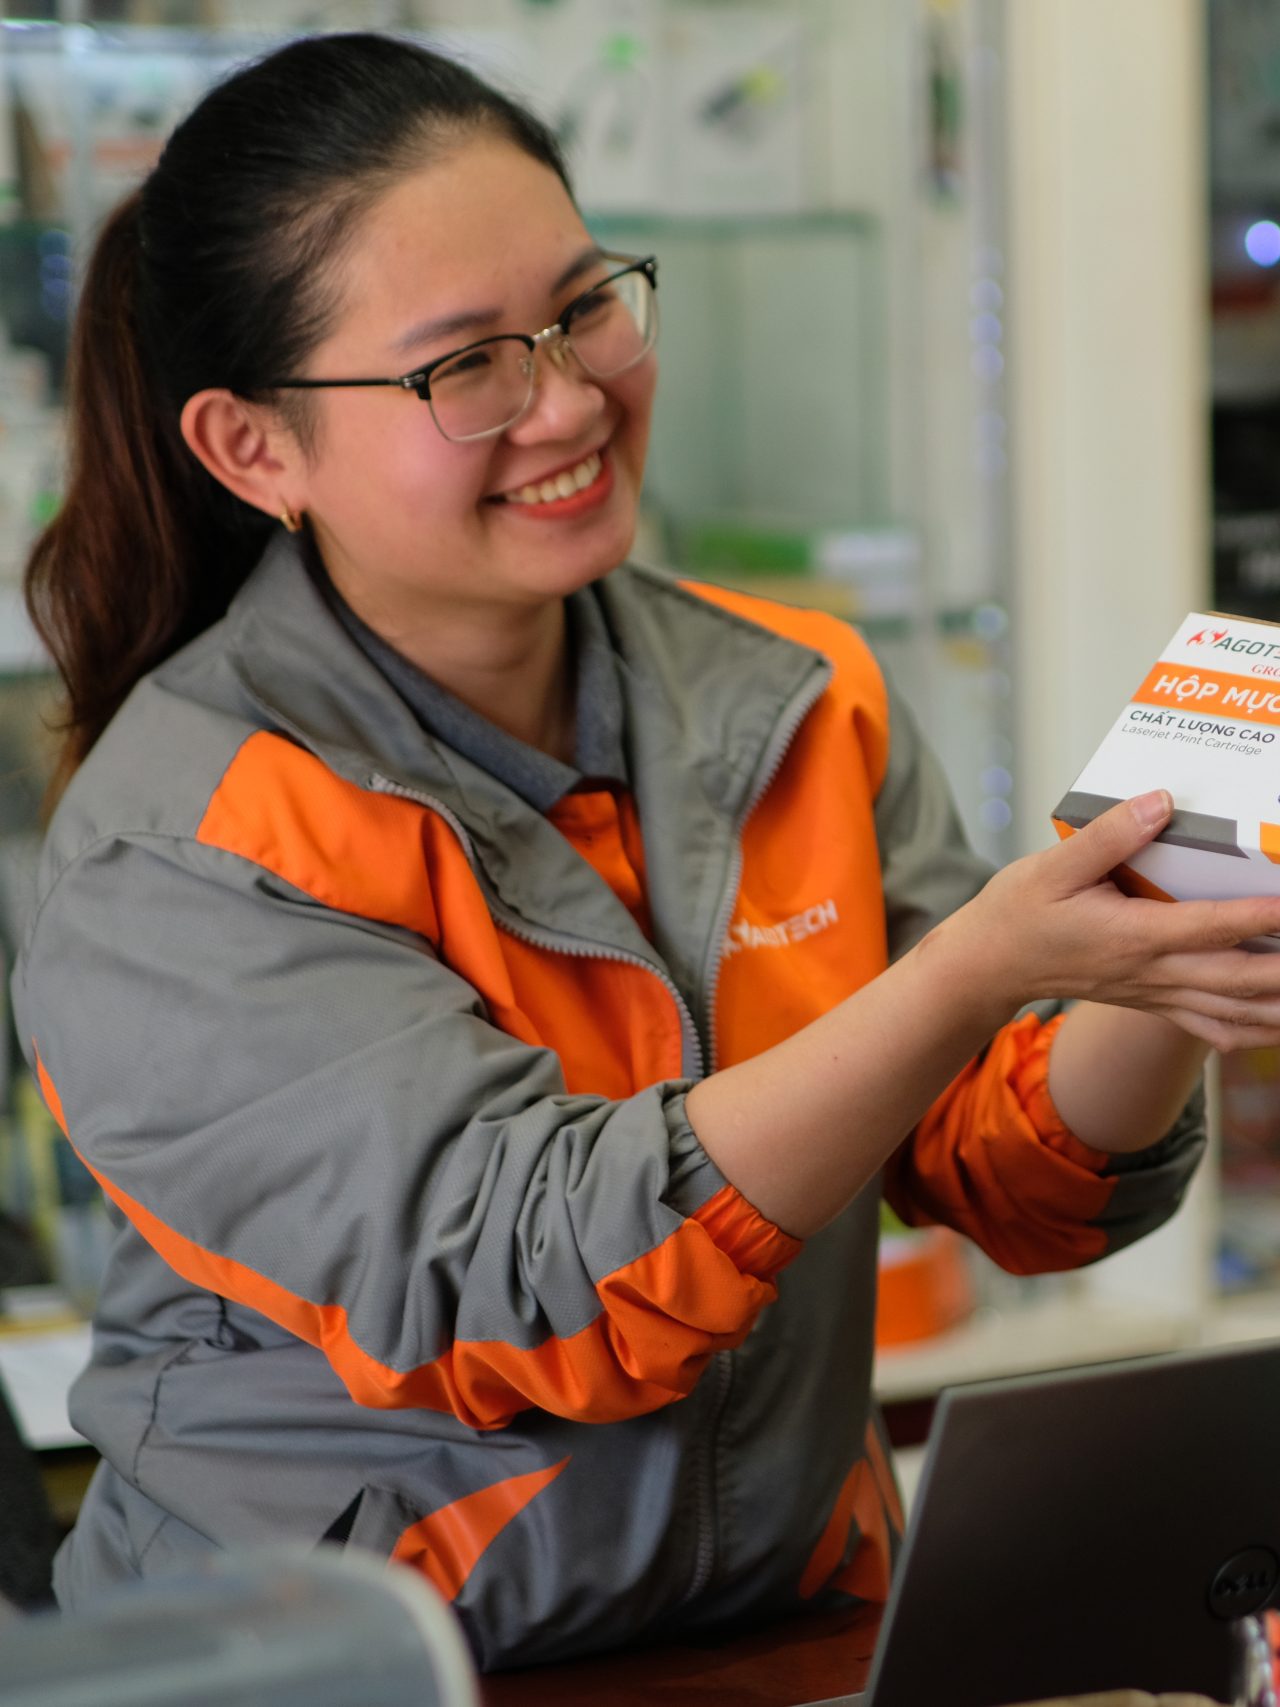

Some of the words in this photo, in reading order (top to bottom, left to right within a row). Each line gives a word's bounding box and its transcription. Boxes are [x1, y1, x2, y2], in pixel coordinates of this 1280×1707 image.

[1153, 674, 1220, 702] HỘP
[1121, 723, 1170, 741] Laserjet
[1172, 731, 1202, 746] Print
[1204, 737, 1263, 756] Cartridge
[1130, 709, 1177, 727] CHẤT
[1177, 717, 1236, 738] LƯỢNG
[1239, 729, 1276, 744] CAO
